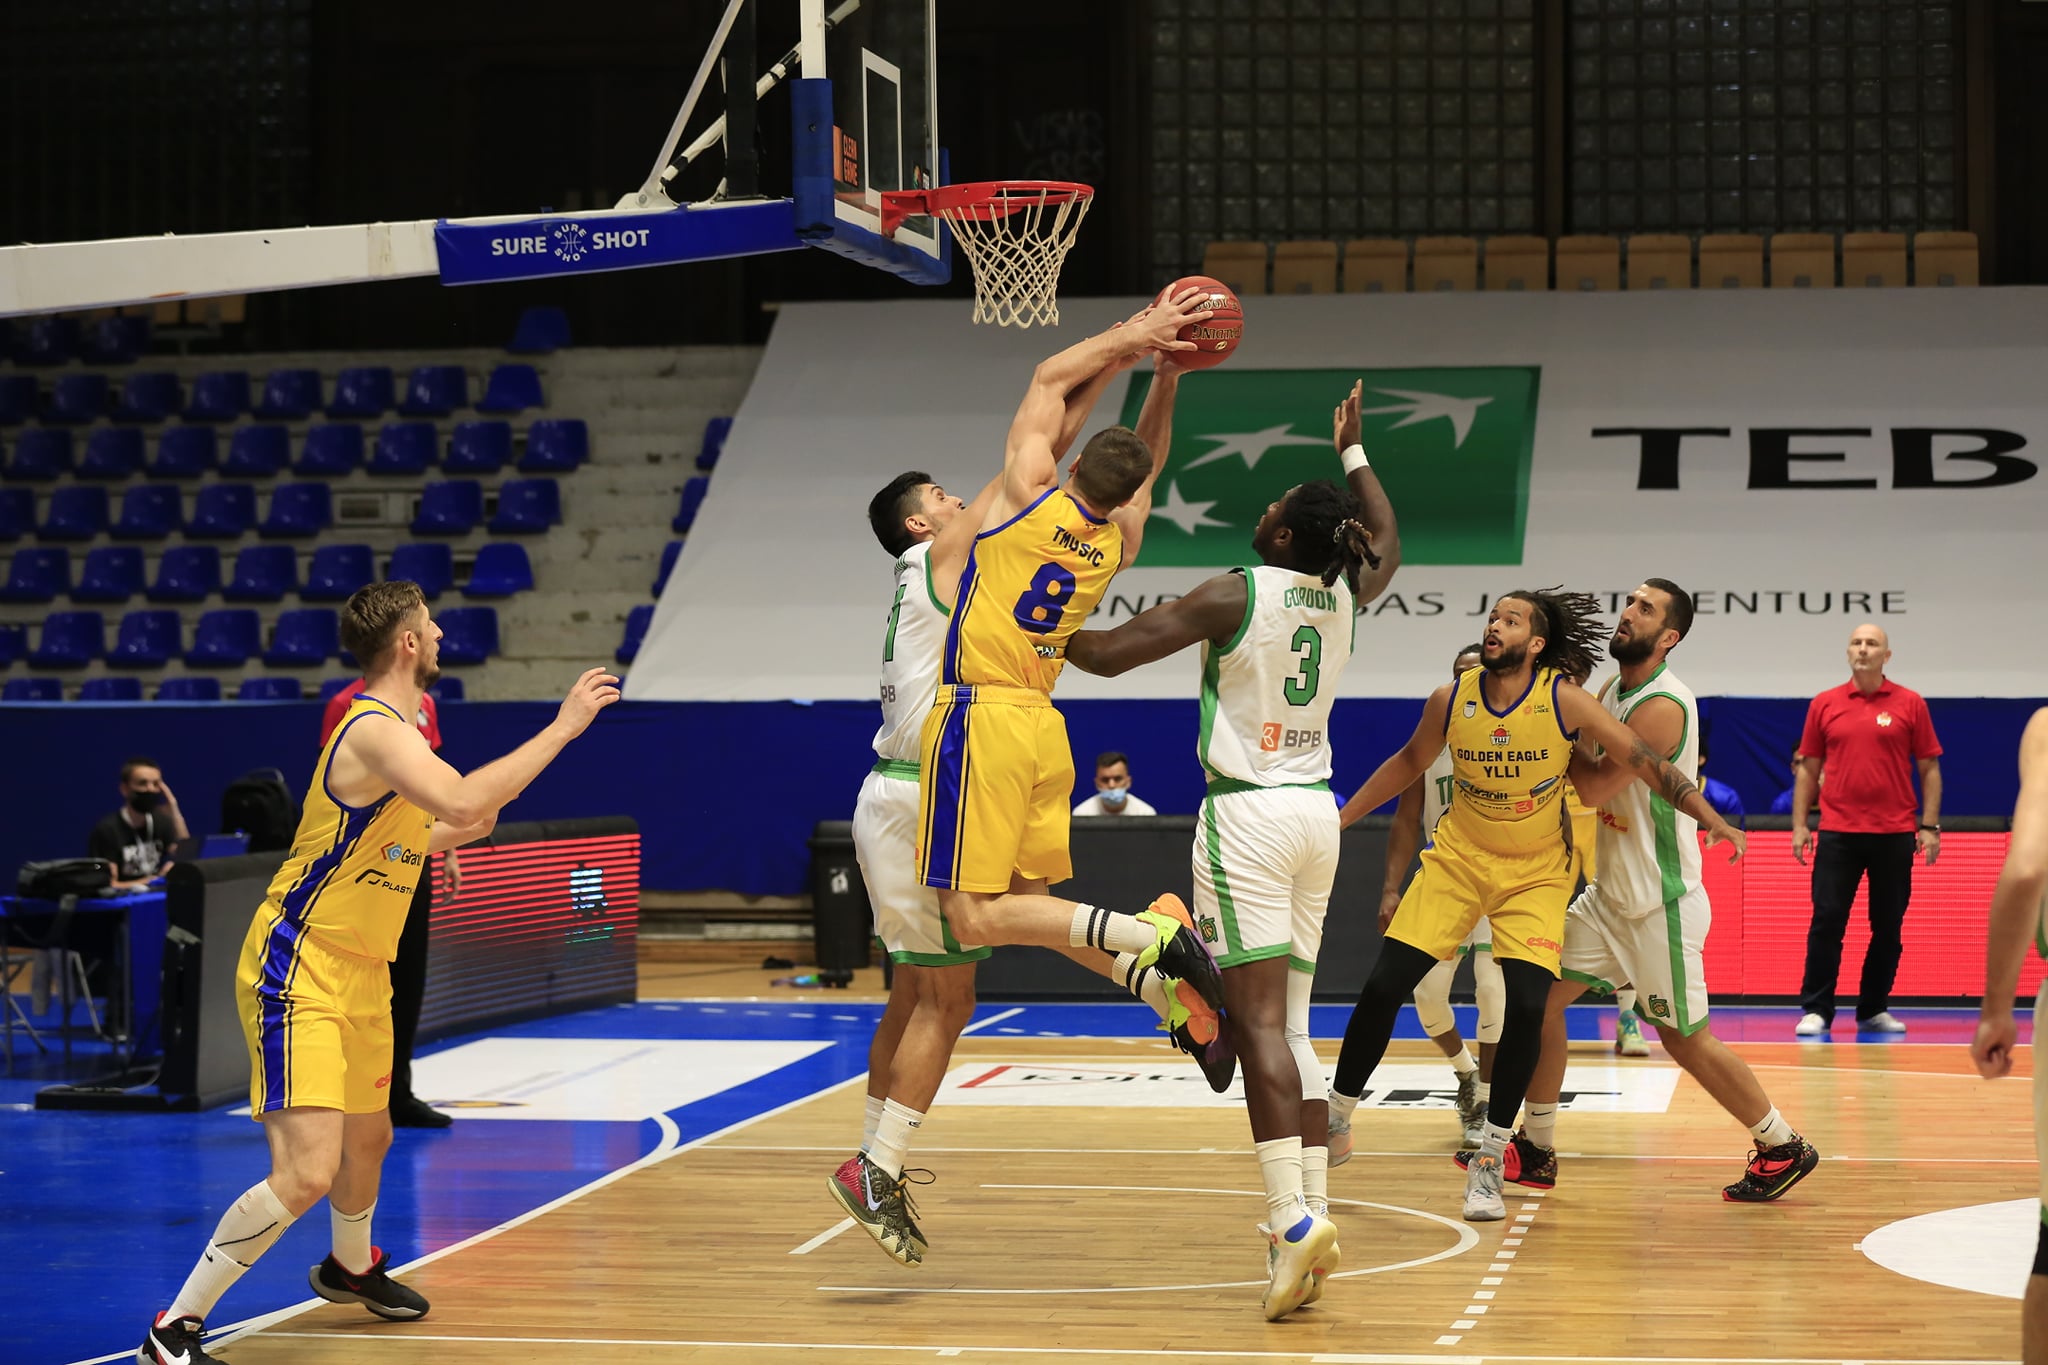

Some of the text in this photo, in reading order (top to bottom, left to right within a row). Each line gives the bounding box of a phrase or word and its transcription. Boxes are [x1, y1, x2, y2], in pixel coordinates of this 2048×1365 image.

[491, 229, 650, 256] SURE SHOT
[554, 223, 587, 239] SURE
[554, 246, 588, 262] SHOT
[1591, 427, 2039, 491] TEB
[1052, 525, 1104, 568] TMUSIC
[1013, 561, 1077, 635] 8
[1283, 586, 1337, 613] GORDON
[1692, 590, 1907, 615] ENTURE
[1283, 625, 1322, 707] 3
[880, 685, 896, 704] PB
[1284, 729, 1322, 748] BPB
[1457, 748, 1549, 762] GOLDEN EAGLE
[1483, 765, 1520, 778] YLLI
